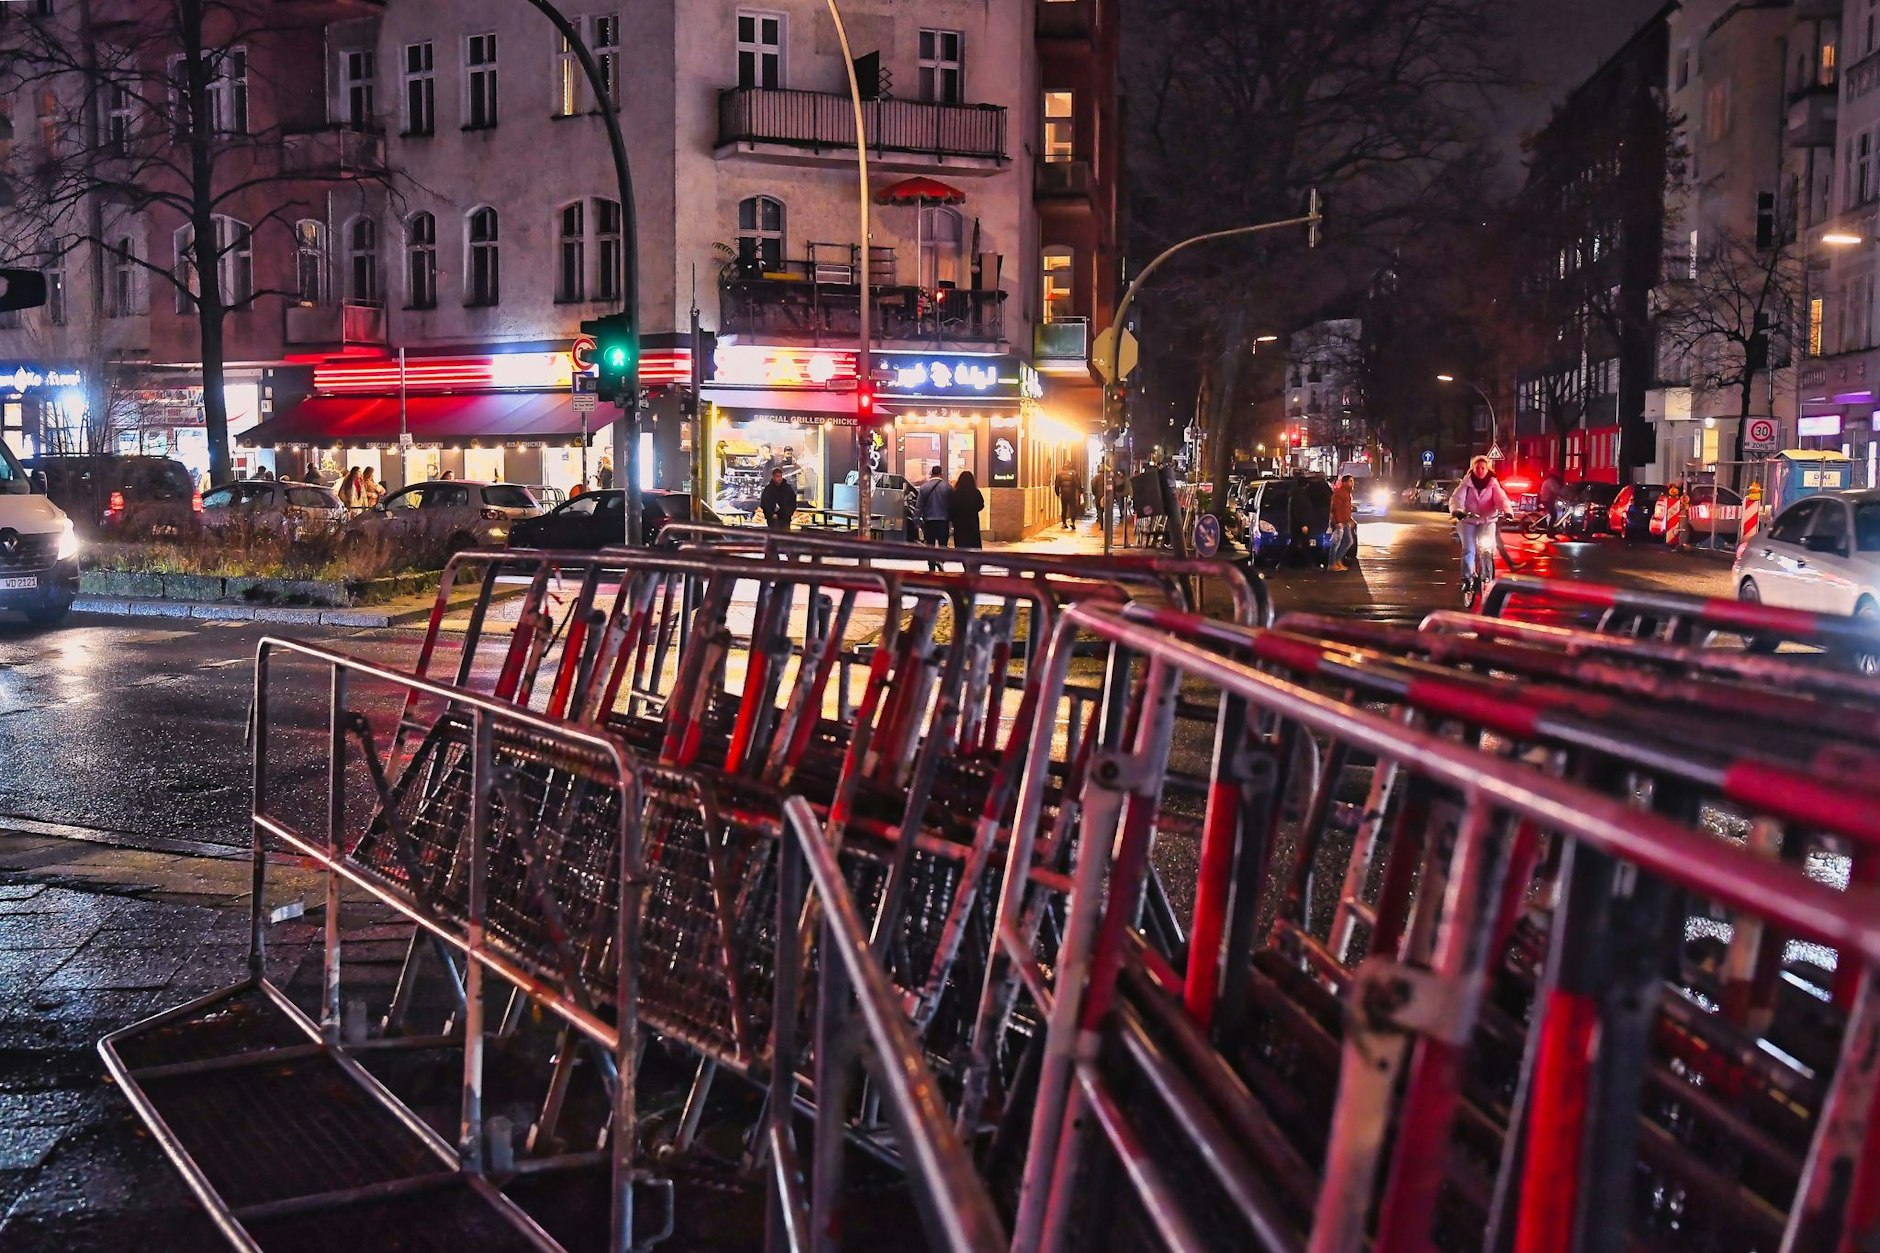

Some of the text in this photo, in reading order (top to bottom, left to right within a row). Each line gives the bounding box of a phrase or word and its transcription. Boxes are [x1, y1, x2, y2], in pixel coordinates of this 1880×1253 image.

[753, 414, 859, 426] SPECIAL GRILLED CHICKE
[1755, 426, 1768, 437] 30
[5, 578, 36, 588] WD 2121
